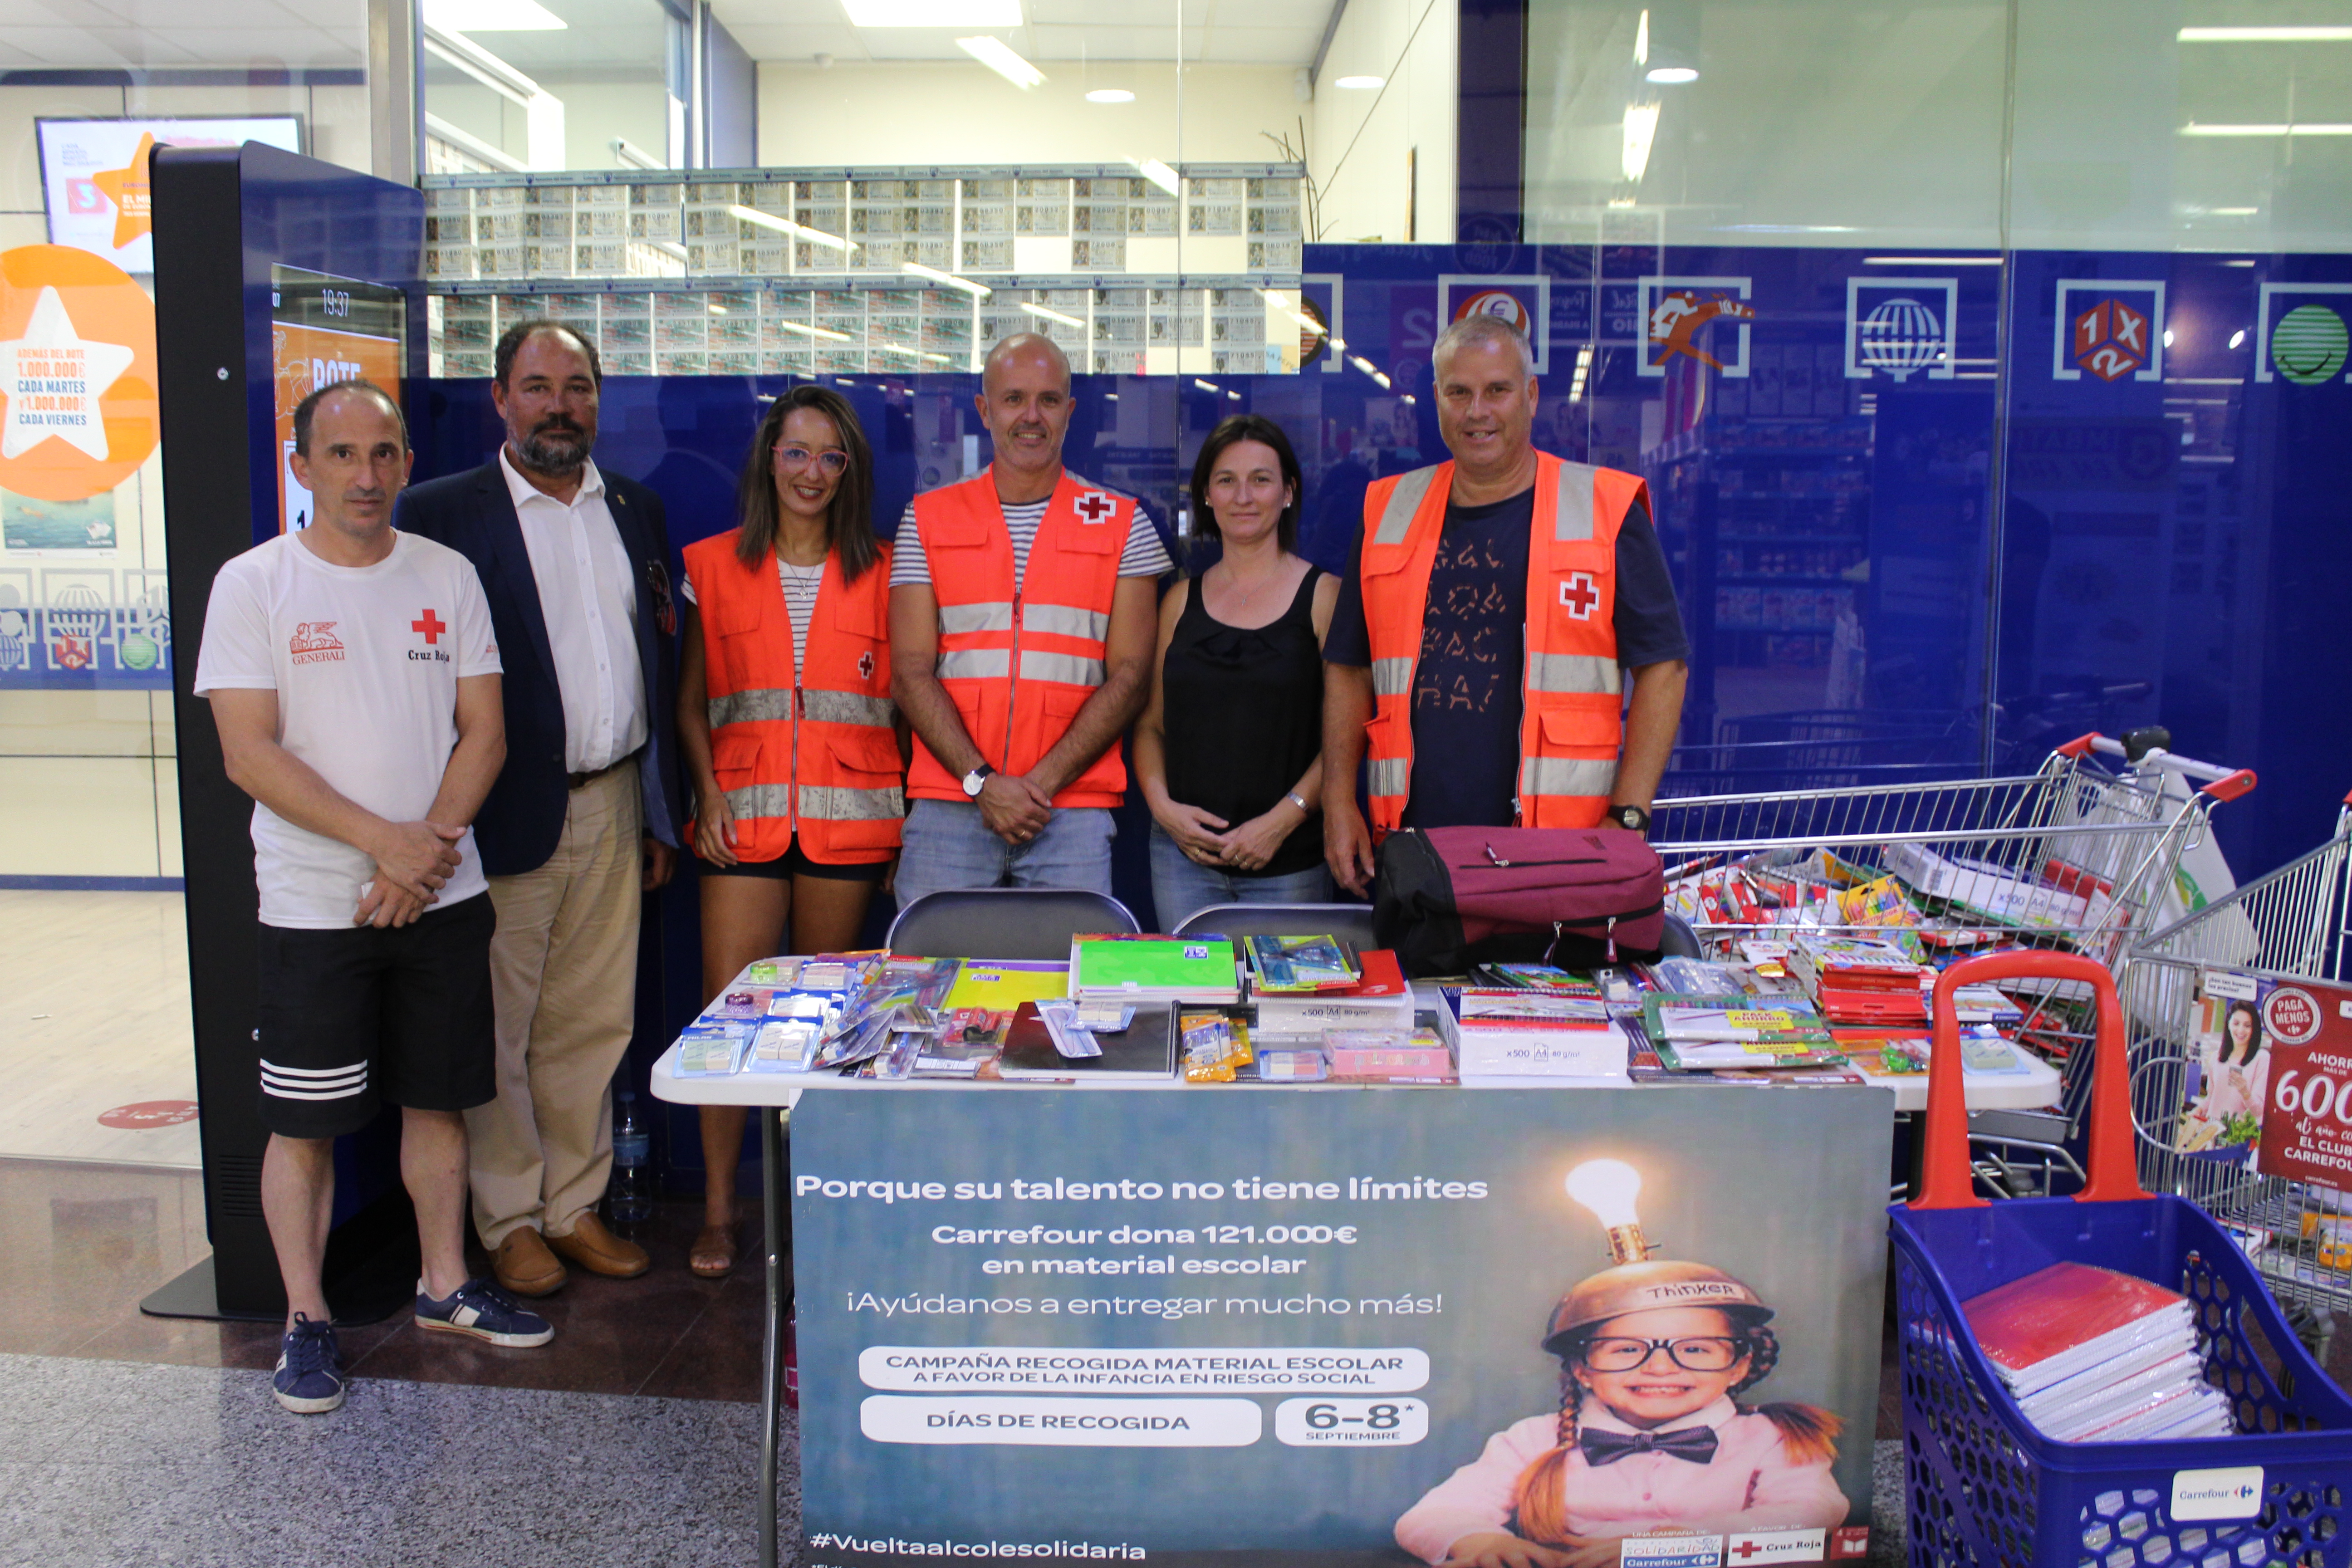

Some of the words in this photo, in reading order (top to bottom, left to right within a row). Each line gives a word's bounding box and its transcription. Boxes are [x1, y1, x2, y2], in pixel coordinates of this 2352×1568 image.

[322, 288, 349, 318] 19:37
[18, 380, 44, 393] CADA
[46, 380, 86, 394] MARTES
[19, 413, 44, 425] CADA
[46, 414, 88, 426] VIERNES
[293, 651, 345, 665] GENERALI
[408, 650, 431, 661] Cruz
[435, 650, 450, 664] Roja
[1301, 1008, 1323, 1016] x500
[1328, 1007, 1339, 1016] A4
[2277, 999, 2304, 1012] PAGA
[2275, 1010, 2310, 1025] MENOS
[1507, 1049, 1530, 1058] x500
[1536, 1049, 1548, 1058] A4
[2299, 1135, 2315, 1149] EL
[797, 1176, 946, 1203] Porque
[955, 1183, 1001, 1199] su
[1010, 1177, 1163, 1200] talento
[1173, 1183, 1224, 1199] no
[1232, 1176, 1339, 1199] tiene
[1350, 1176, 1488, 1200] límites
[932, 1225, 1102, 1244] Carrefour
[1109, 1225, 1195, 1244] dona
[1202, 1225, 1357, 1244] 121.000€
[983, 1260, 1024, 1274] en
[1032, 1255, 1174, 1274] material
[1182, 1255, 1306, 1274] escolar
[848, 1292, 1032, 1317] ¡Ayúdanos
[1040, 1298, 1058, 1313] a
[1068, 1297, 1217, 1319] entregar
[1226, 1294, 1351, 1313] mucho
[1360, 1294, 1441, 1314] más!
[887, 1353, 1010, 1368] CAMPAÑA
[1017, 1357, 1148, 1369] RECOGIDA
[1155, 1358, 1280, 1369] MATERIAL
[1287, 1358, 1402, 1369] ESCOLAR
[914, 1372, 927, 1382] A
[933, 1372, 1004, 1382] FAVOR
[1010, 1373, 1037, 1382] DE
[1043, 1373, 1068, 1382] LA
[1074, 1374, 1174, 1384] INFANCIA
[1181, 1374, 1207, 1383] EN
[1214, 1374, 1293, 1383] RIESGO
[1298, 1373, 1375, 1384] SOCIAL
[927, 1411, 991, 1427] DÍAS
[999, 1415, 1034, 1427] DE
[1042, 1416, 1189, 1429] RECOGIDA
[1306, 1432, 1400, 1441] SEPTIEMBRE
[2179, 1488, 2230, 1500] Carrefour
[809, 1532, 1146, 1561] #Vueltaalcolesolidaria
[1766, 1543, 1793, 1552] Cruz
[1797, 1540, 1822, 1550] Roja
[1627, 1557, 1687, 1568] Carrefour
